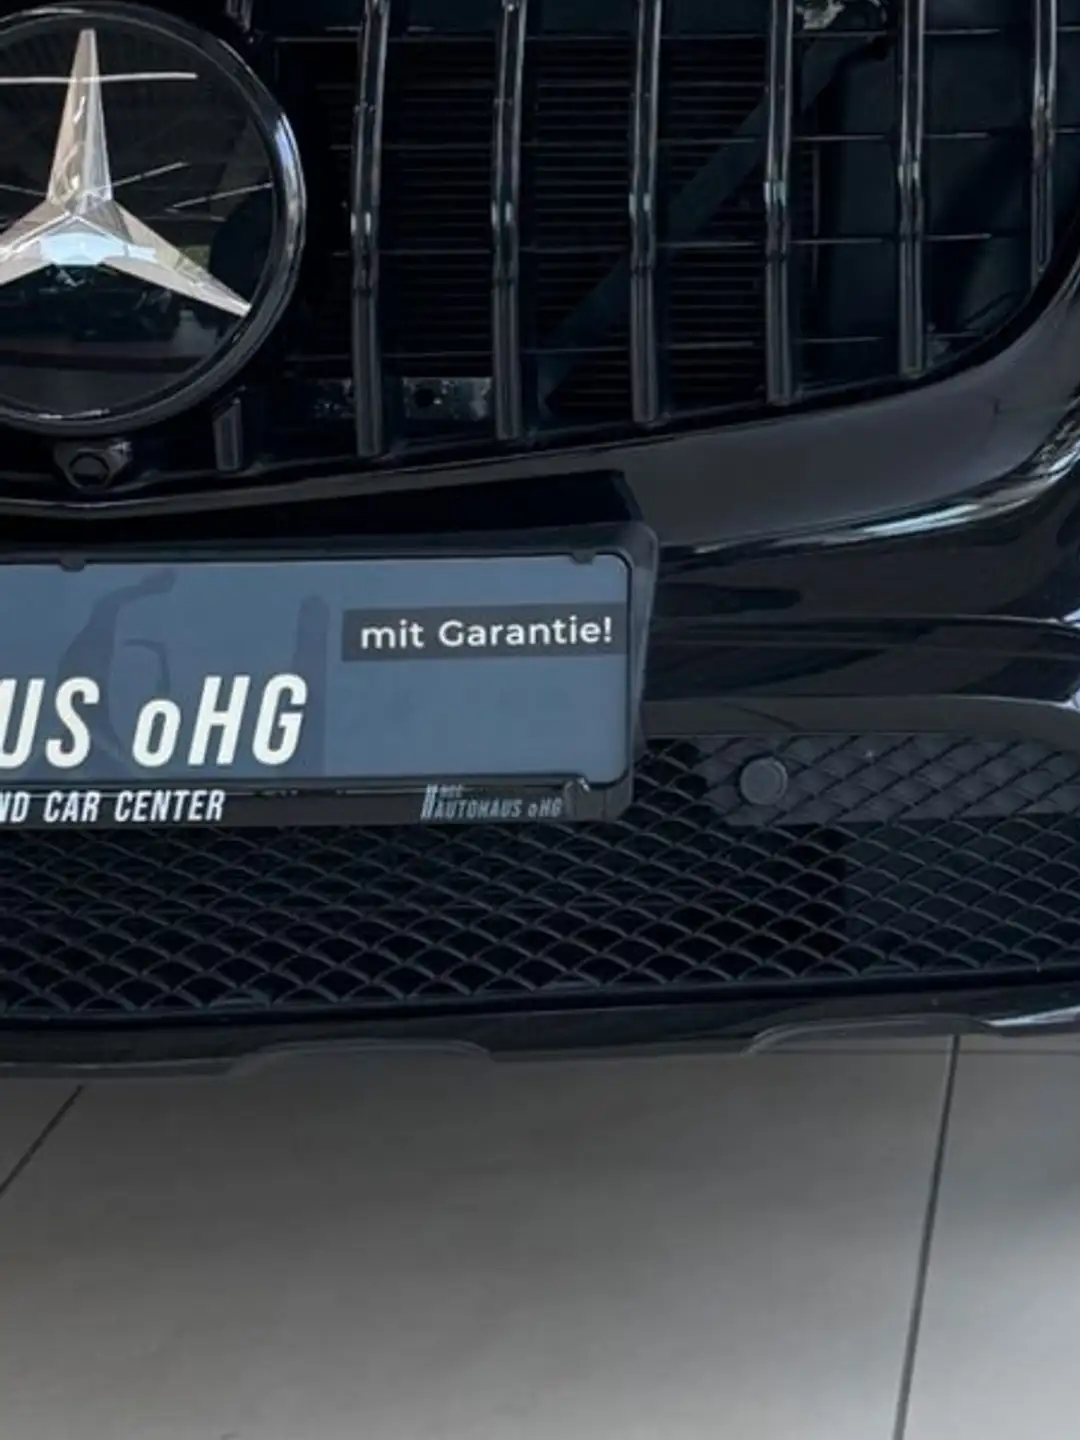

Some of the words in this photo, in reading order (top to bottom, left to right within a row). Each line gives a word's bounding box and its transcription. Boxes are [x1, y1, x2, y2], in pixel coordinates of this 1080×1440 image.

[361, 619, 425, 649] mit
[438, 615, 613, 647] Garantie!
[132, 673, 307, 768] oHG
[43, 790, 101, 822] CAR
[114, 789, 226, 822] CENTER
